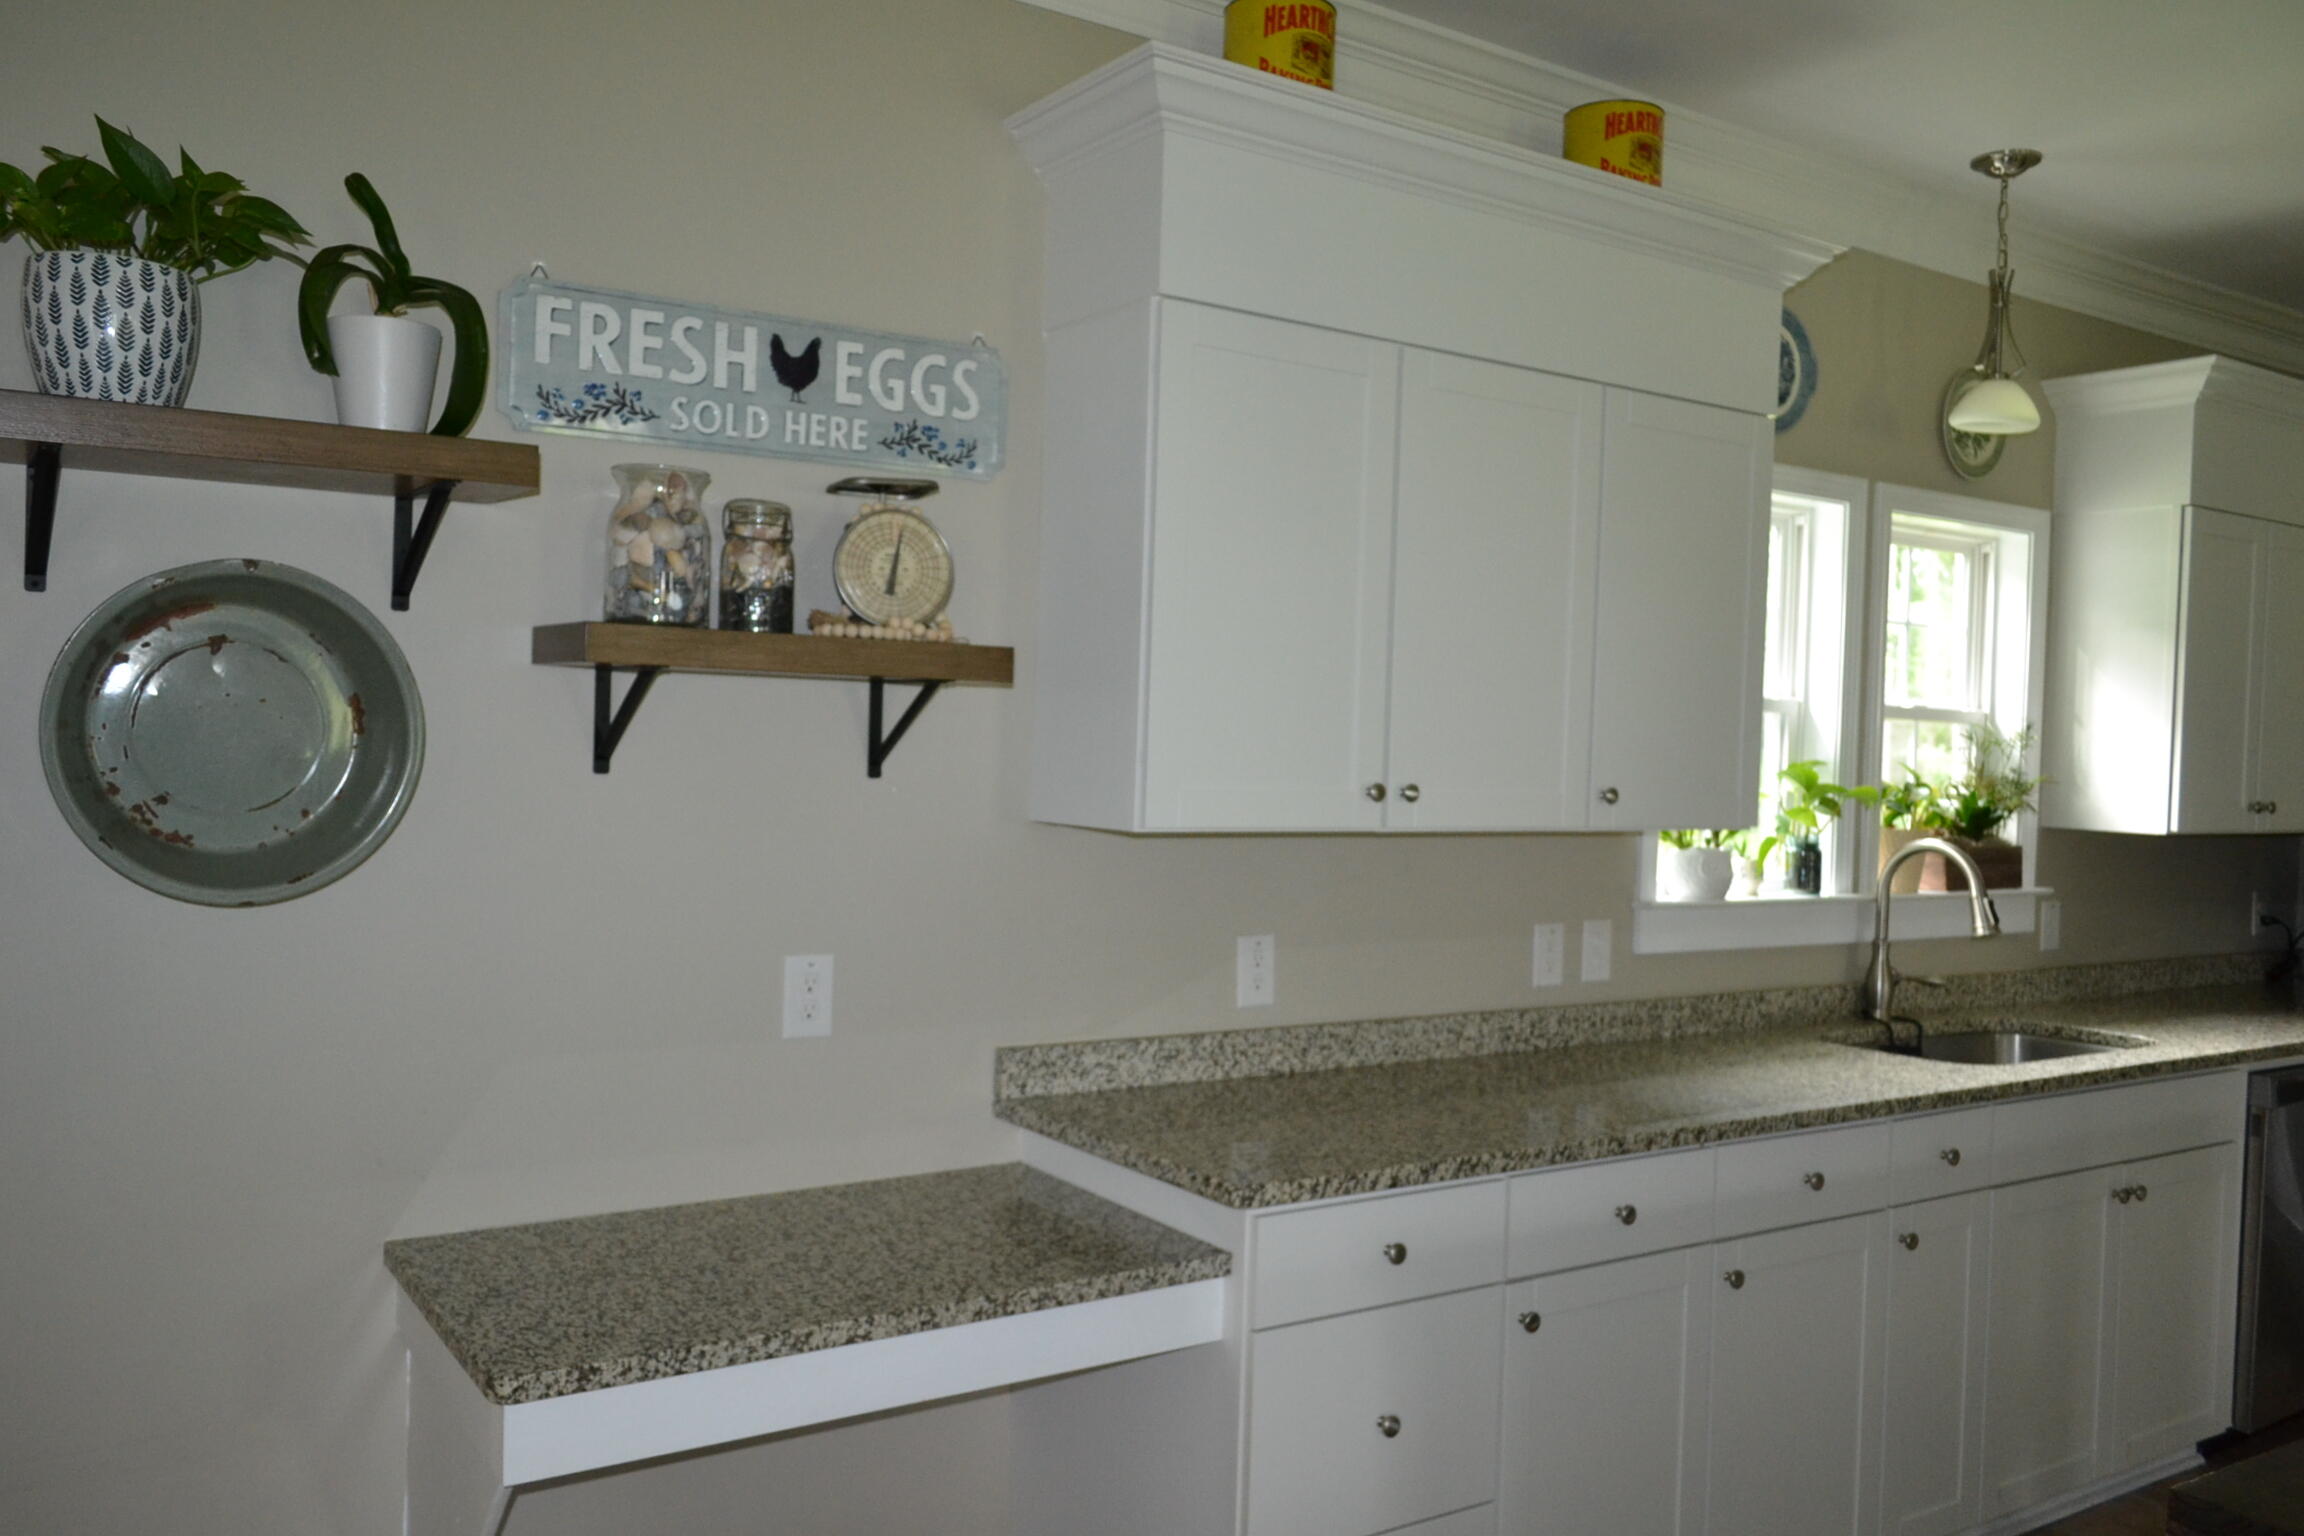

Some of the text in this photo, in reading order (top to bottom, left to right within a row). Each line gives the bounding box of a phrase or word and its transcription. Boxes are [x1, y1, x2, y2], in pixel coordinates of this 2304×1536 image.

[533, 293, 981, 421] FRESH EGGS
[669, 396, 869, 452] SOLD HERE
